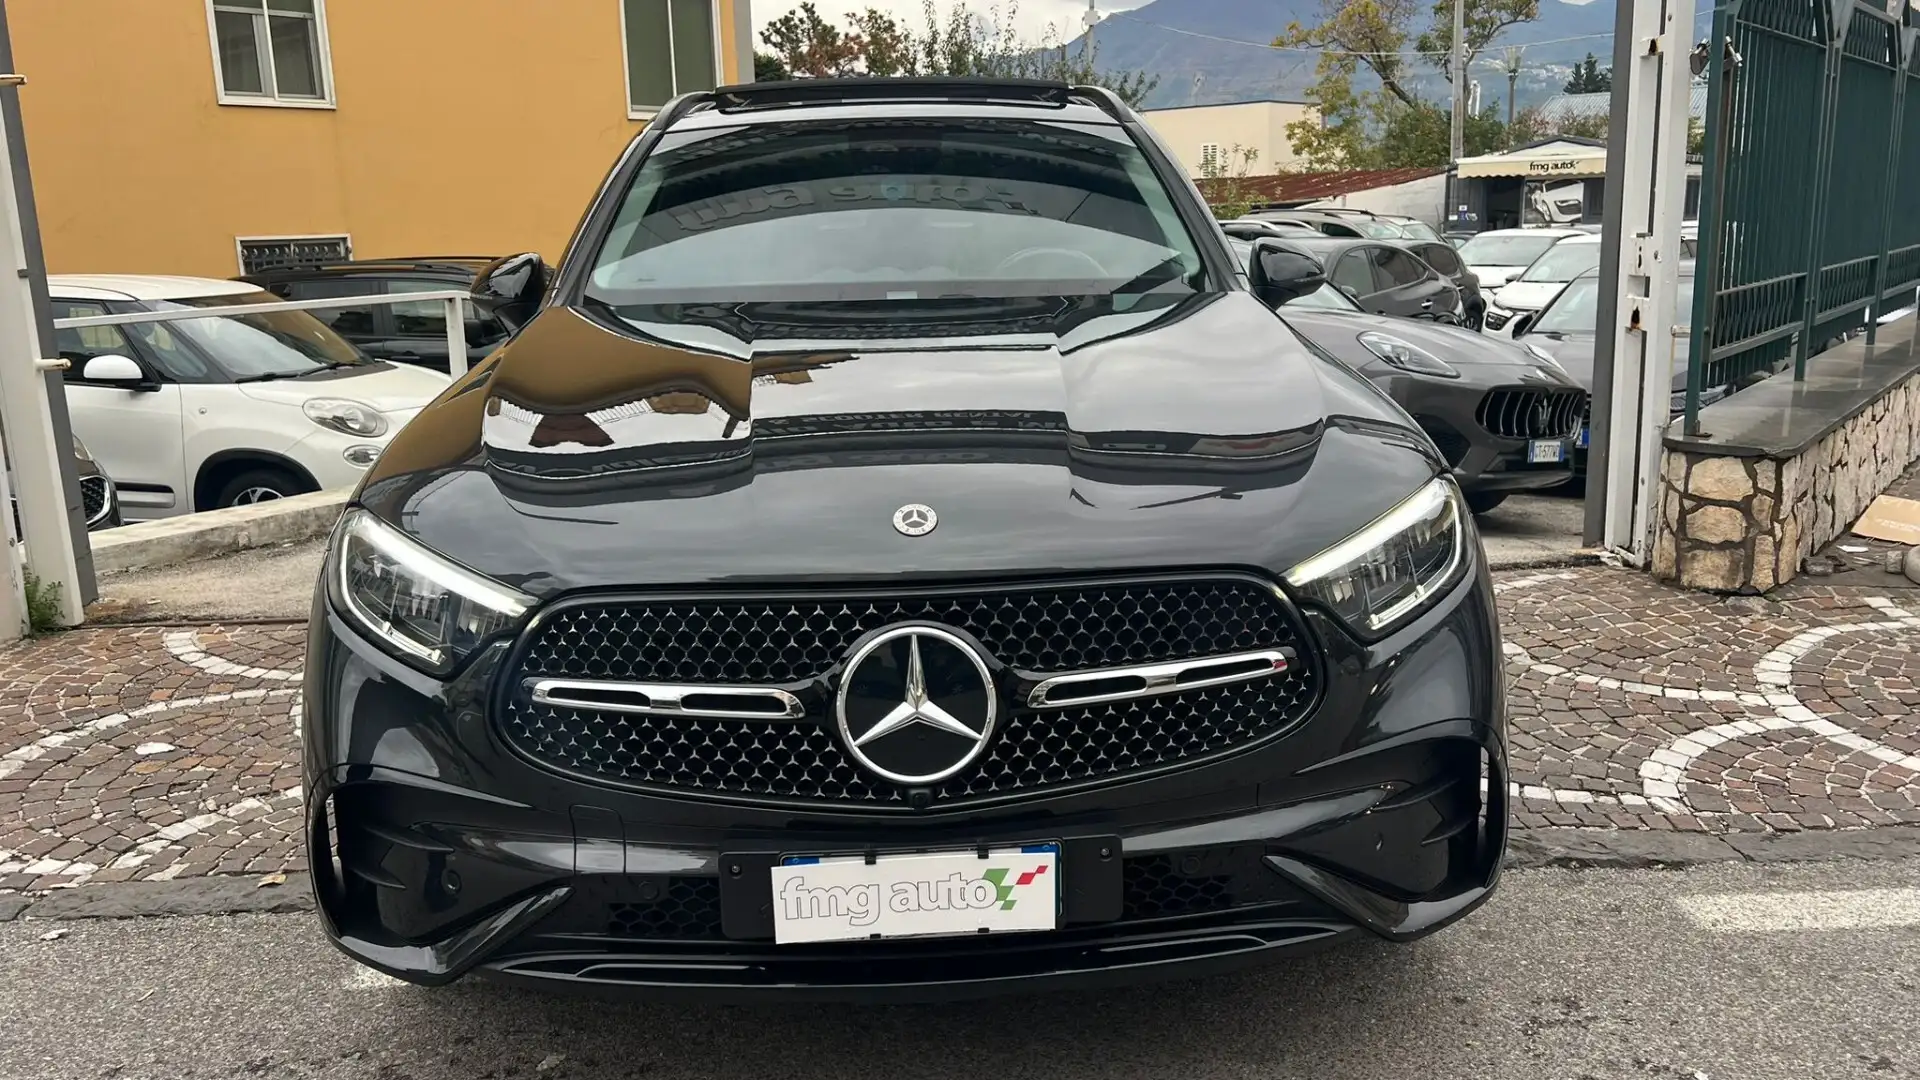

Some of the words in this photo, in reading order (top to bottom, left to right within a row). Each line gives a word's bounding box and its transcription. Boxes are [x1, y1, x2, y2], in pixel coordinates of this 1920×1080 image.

[1529, 161, 1549, 172] fmg
[1551, 161, 1573, 170] auto
[780, 875, 880, 926] fmg
[889, 873, 998, 912] auto
